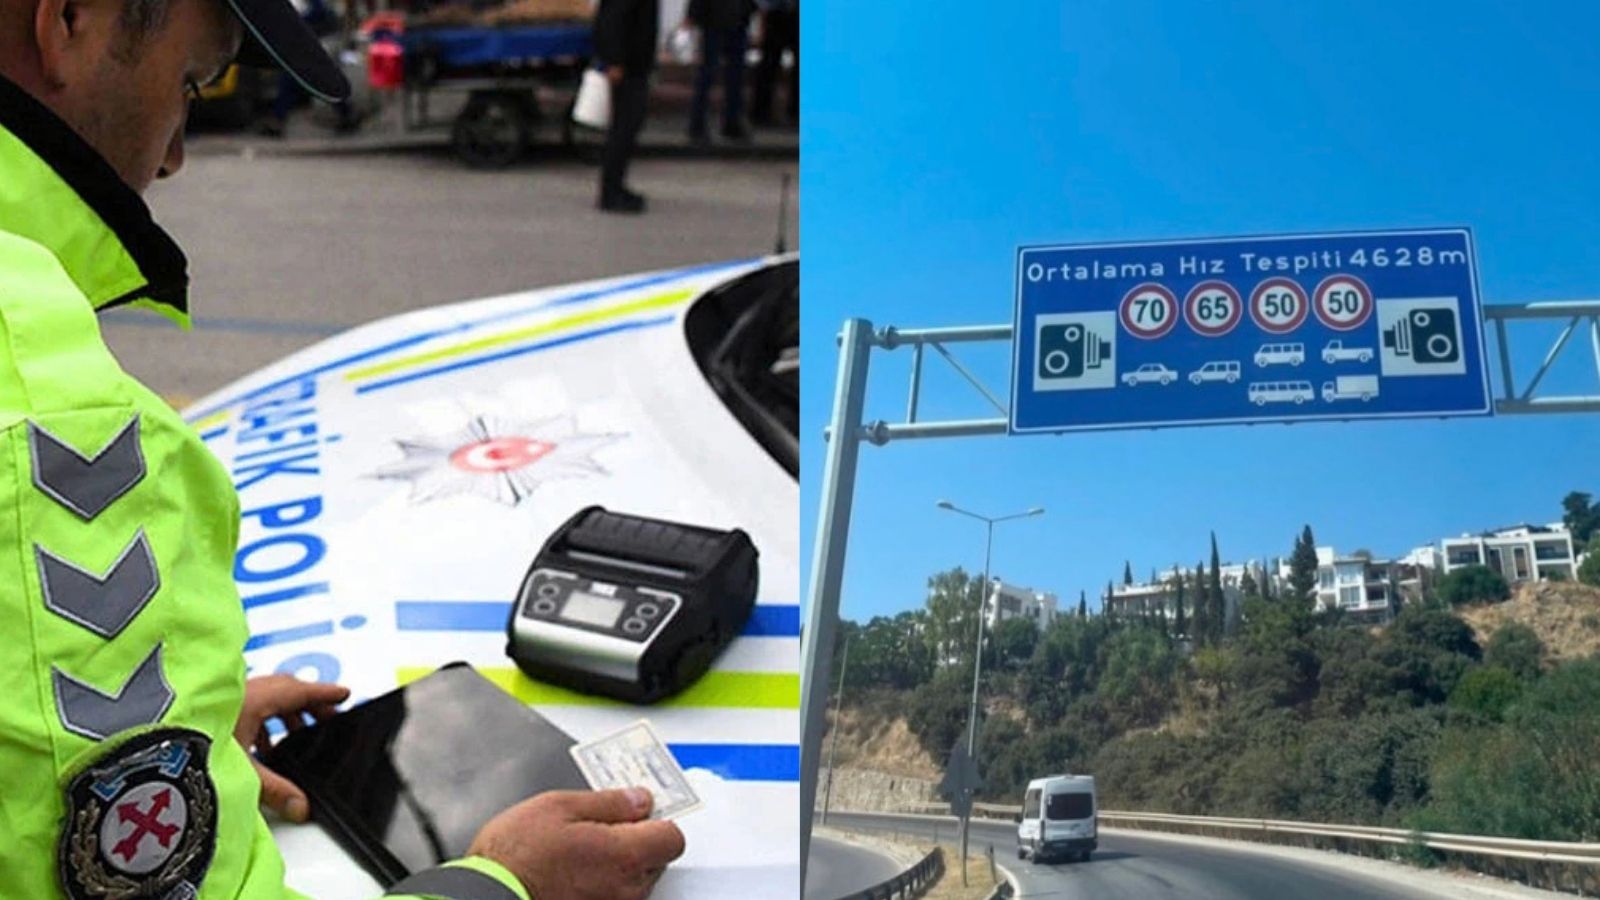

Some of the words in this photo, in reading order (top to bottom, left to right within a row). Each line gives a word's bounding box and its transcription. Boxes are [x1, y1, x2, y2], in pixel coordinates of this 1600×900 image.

[1027, 260, 1164, 282] Ortalama
[1240, 250, 1341, 274] Tespiti
[1134, 299, 1166, 324] 70
[1197, 296, 1230, 321] 65
[1264, 293, 1296, 318] 50
[1328, 290, 1359, 315] 50
